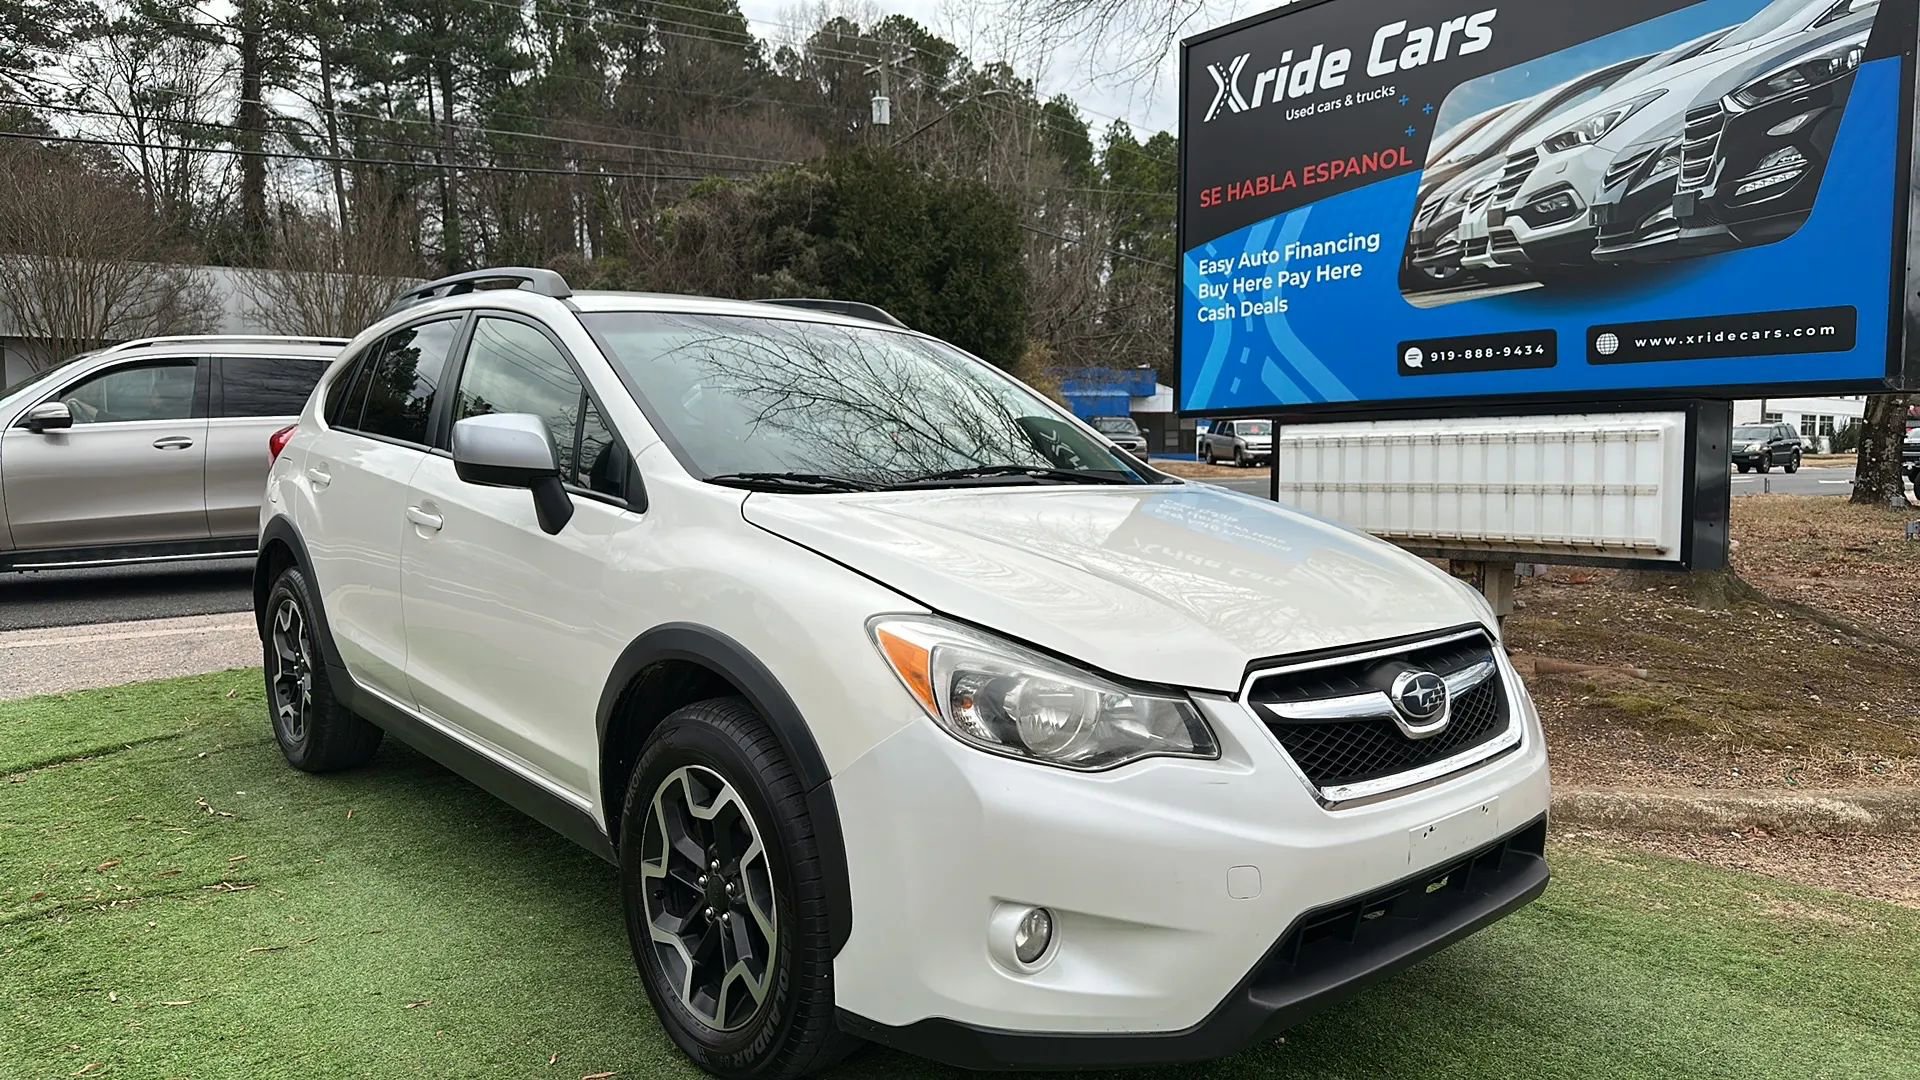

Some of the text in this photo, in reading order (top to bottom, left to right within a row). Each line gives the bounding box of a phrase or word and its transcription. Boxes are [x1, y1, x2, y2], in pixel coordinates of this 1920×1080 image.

[1204, 9, 1497, 122] Xride Cars
[1286, 86, 1395, 120] Used cars & trucks
[1201, 148, 1413, 208] SE HABLA ESPANOL
[1200, 233, 1379, 275] Easy Auto Financing
[1199, 264, 1362, 299] Buy Here Pay Here
[1198, 297, 1287, 322] Cash Deals
[1634, 325, 1835, 346] www.xridecars.com
[1430, 344, 1545, 362] 919-888-9434
